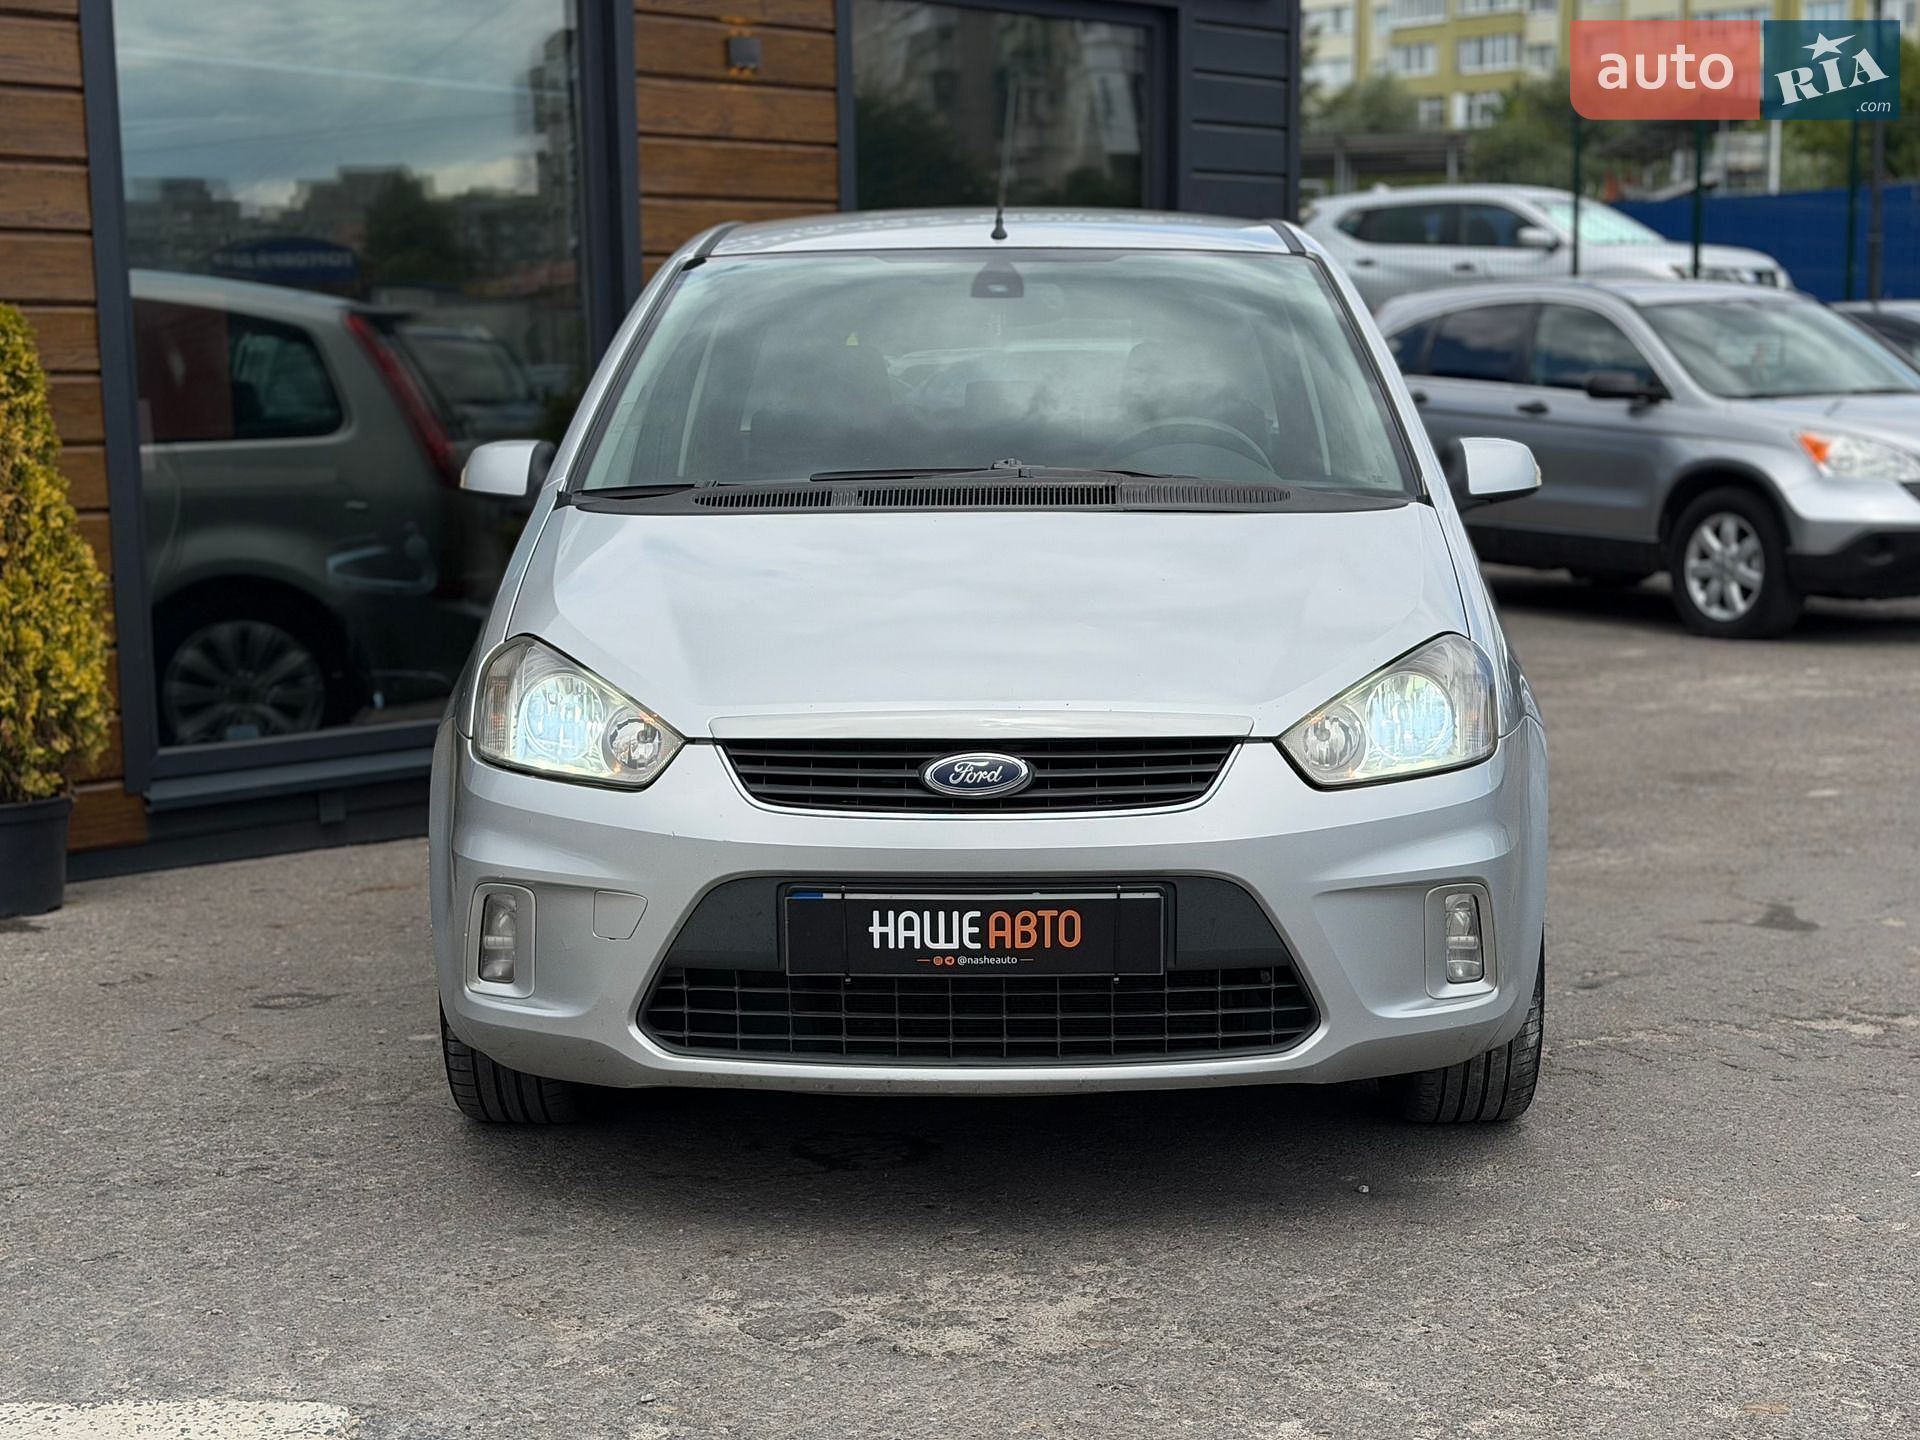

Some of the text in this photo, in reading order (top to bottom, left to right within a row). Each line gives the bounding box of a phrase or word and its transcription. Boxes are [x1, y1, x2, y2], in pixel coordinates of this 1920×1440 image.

[949, 761, 1003, 785] Ford
[868, 909, 1082, 950] НАШЕ АВТО
[957, 956, 1018, 967] @nasheauto
